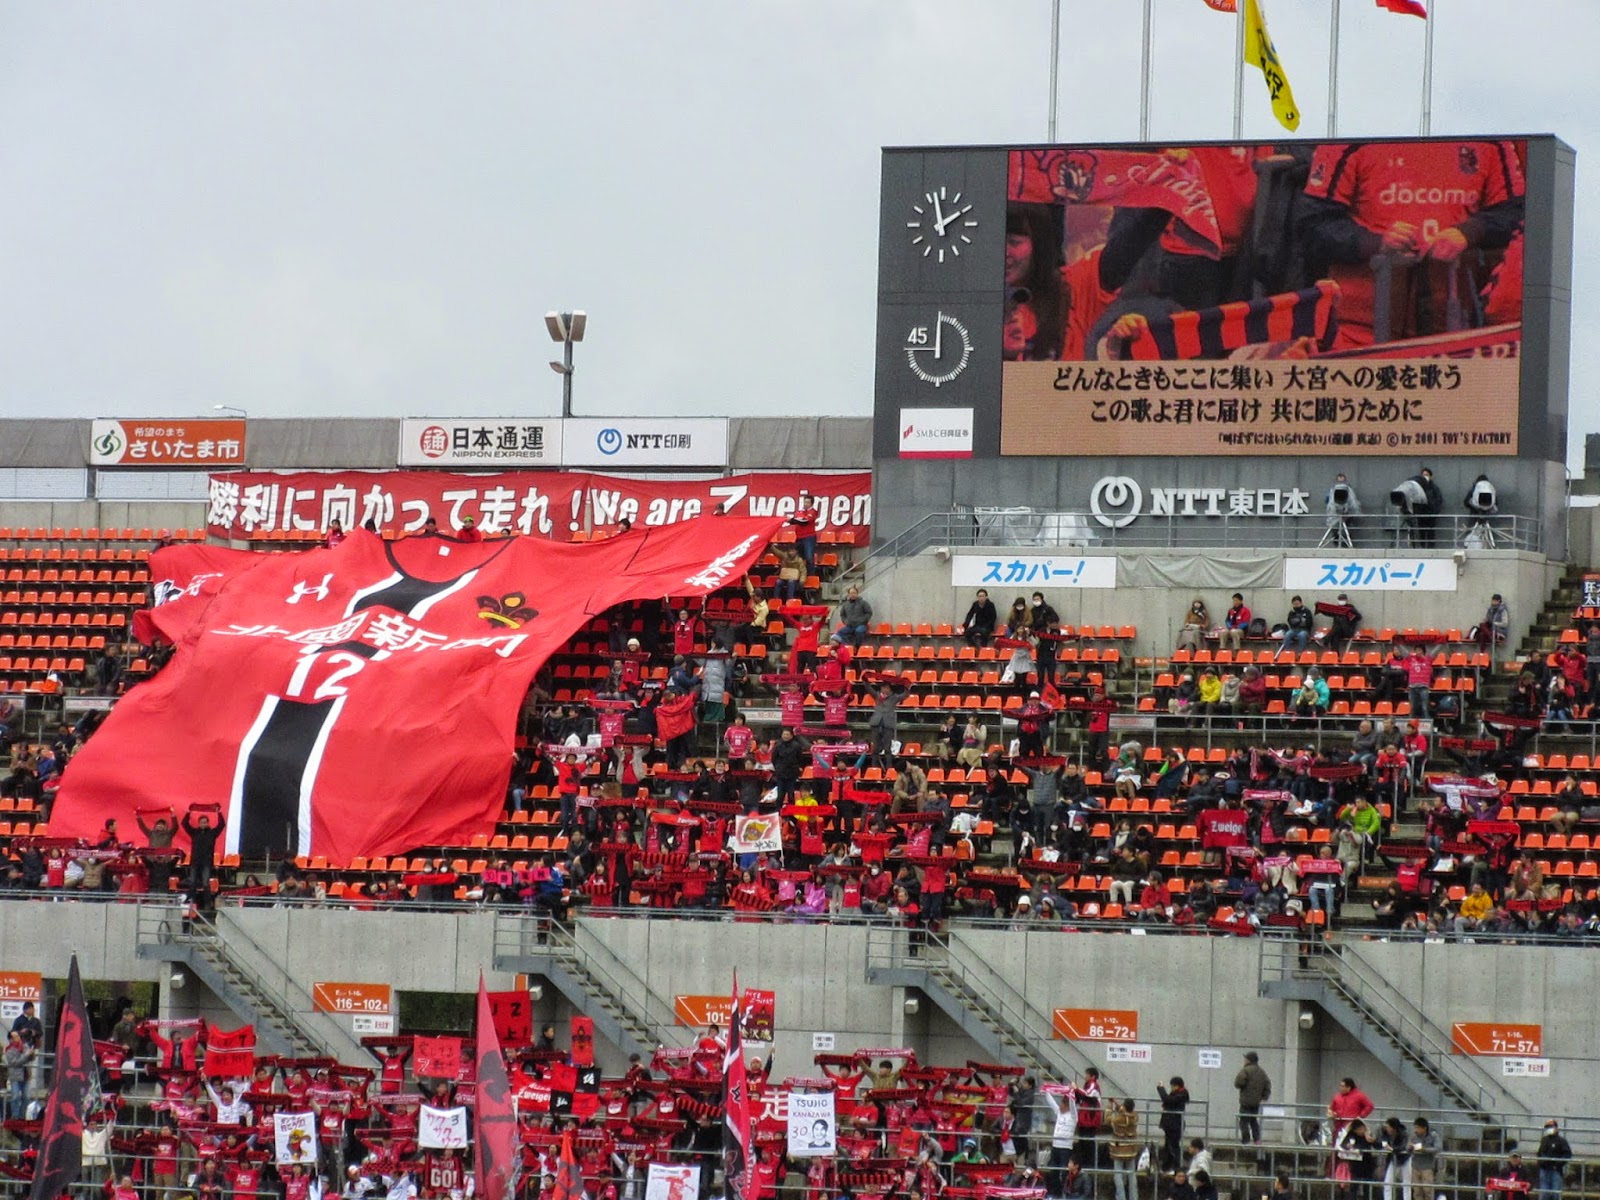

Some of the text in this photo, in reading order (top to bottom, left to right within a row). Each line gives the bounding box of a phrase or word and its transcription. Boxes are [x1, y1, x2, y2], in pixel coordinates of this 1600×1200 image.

[907, 327, 928, 344] 45
[1053, 365, 1462, 391] どんなときもここに集い 大宮への愛を歌う
[1091, 397, 1423, 424] この歌よ君に届け 共に闘うために
[134, 427, 185, 437] 希望のまち
[452, 426, 545, 451] 日本通運
[627, 433, 691, 450] NTT印刷
[129, 439, 240, 459] さいたま市
[591, 488, 638, 527] We
[645, 497, 702, 526] are
[1150, 487, 1310, 517] NTT東日本
[981, 560, 1086, 585] スカパー!
[1317, 562, 1426, 587] スカパー!
[286, 652, 365, 699] 12
[796, 1099, 828, 1108] TSUJIO
[791, 1126, 808, 1139] 30
[431, 1168, 458, 1188] GO!
